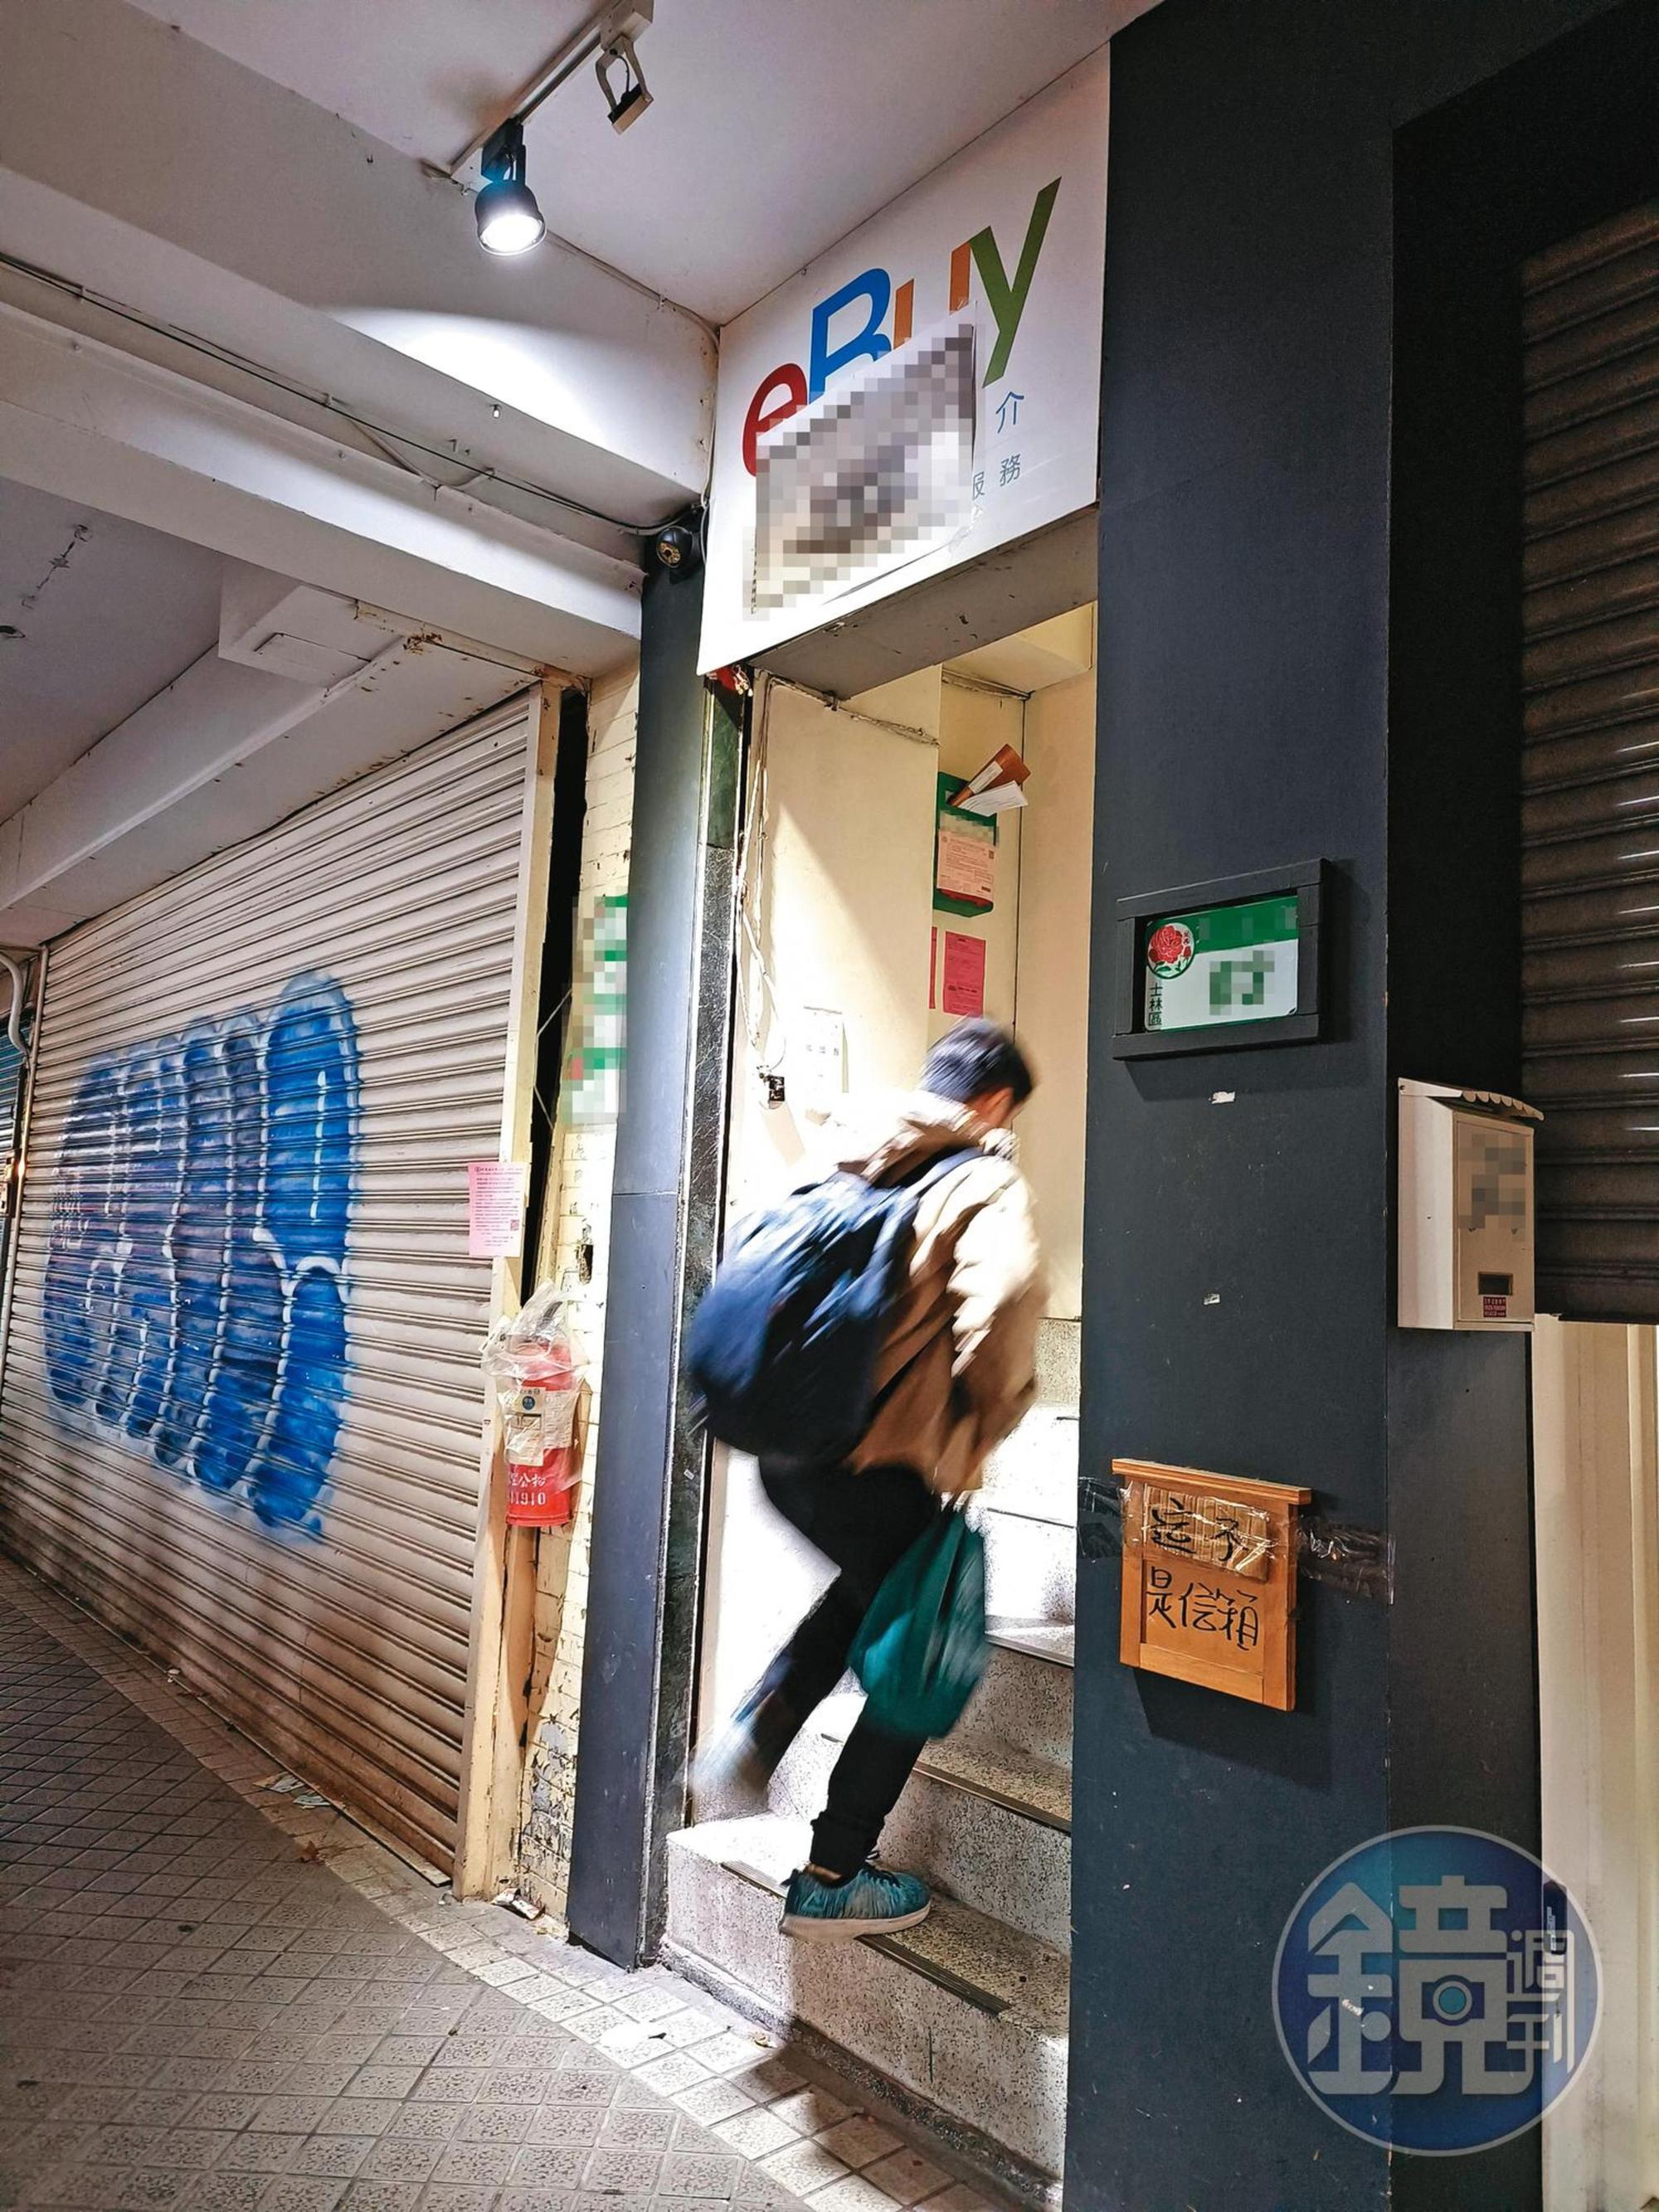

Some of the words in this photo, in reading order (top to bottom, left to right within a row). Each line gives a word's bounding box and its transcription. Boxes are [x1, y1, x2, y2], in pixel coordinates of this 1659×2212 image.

[1149, 983, 1163, 1026] 士林區
[1146, 1566, 1258, 1650] 是信箱
